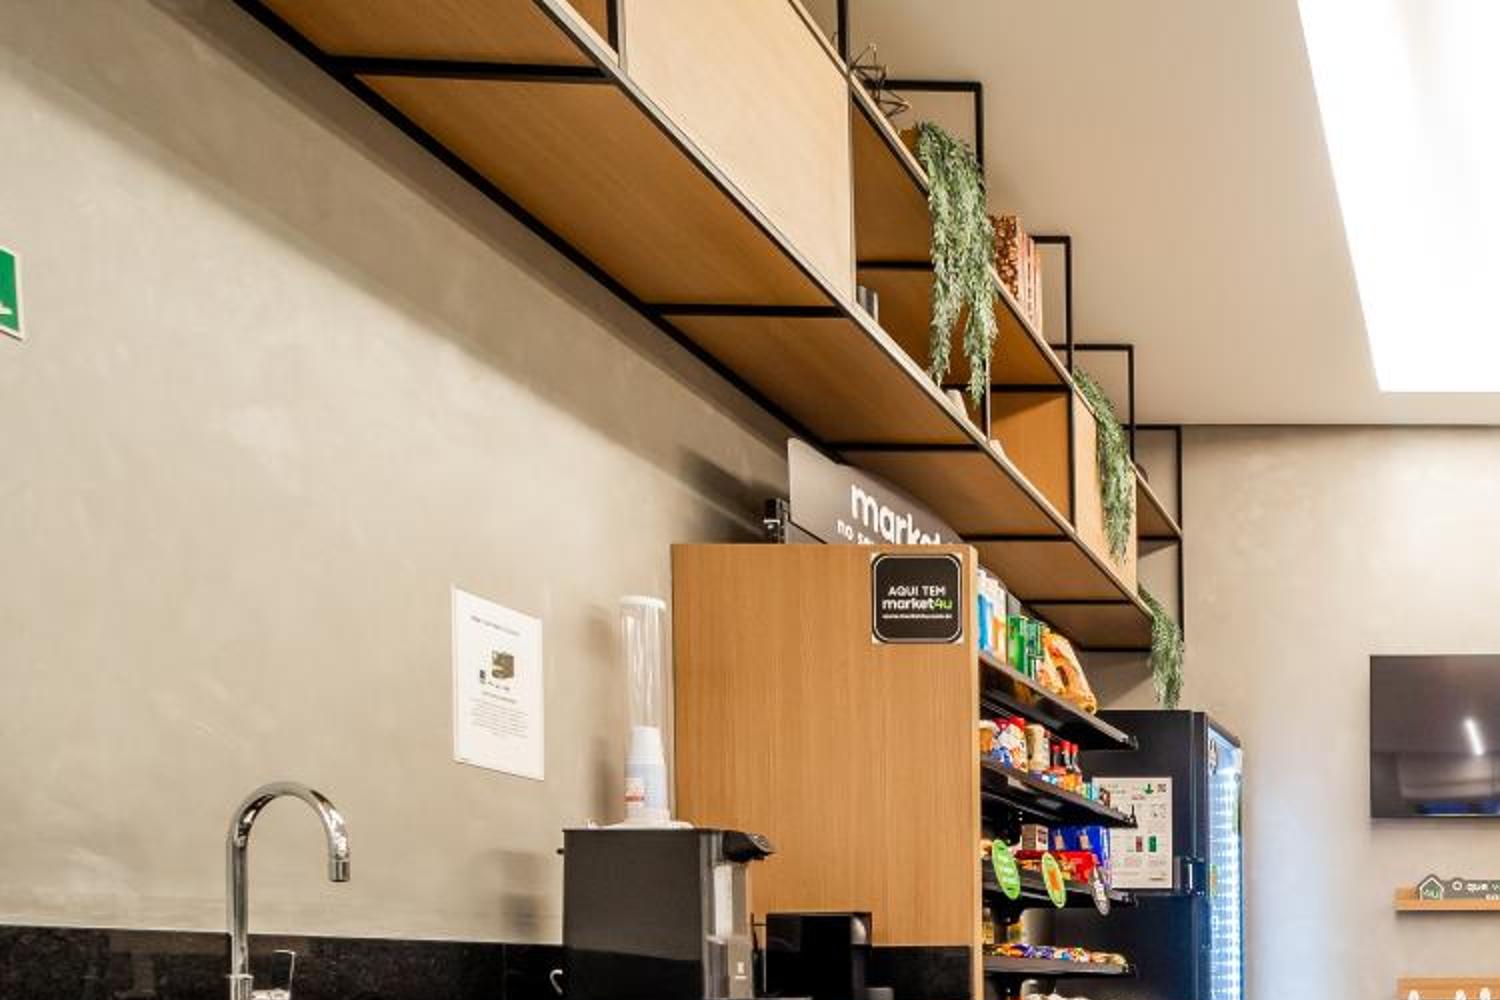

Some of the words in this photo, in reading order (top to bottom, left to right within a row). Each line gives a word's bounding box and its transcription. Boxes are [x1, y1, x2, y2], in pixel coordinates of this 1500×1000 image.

[888, 585, 918, 597] AQUI
[922, 585, 946, 597] TEM
[882, 597, 953, 609] market4u
[1451, 881, 1463, 892] O
[1467, 883, 1488, 893] que
